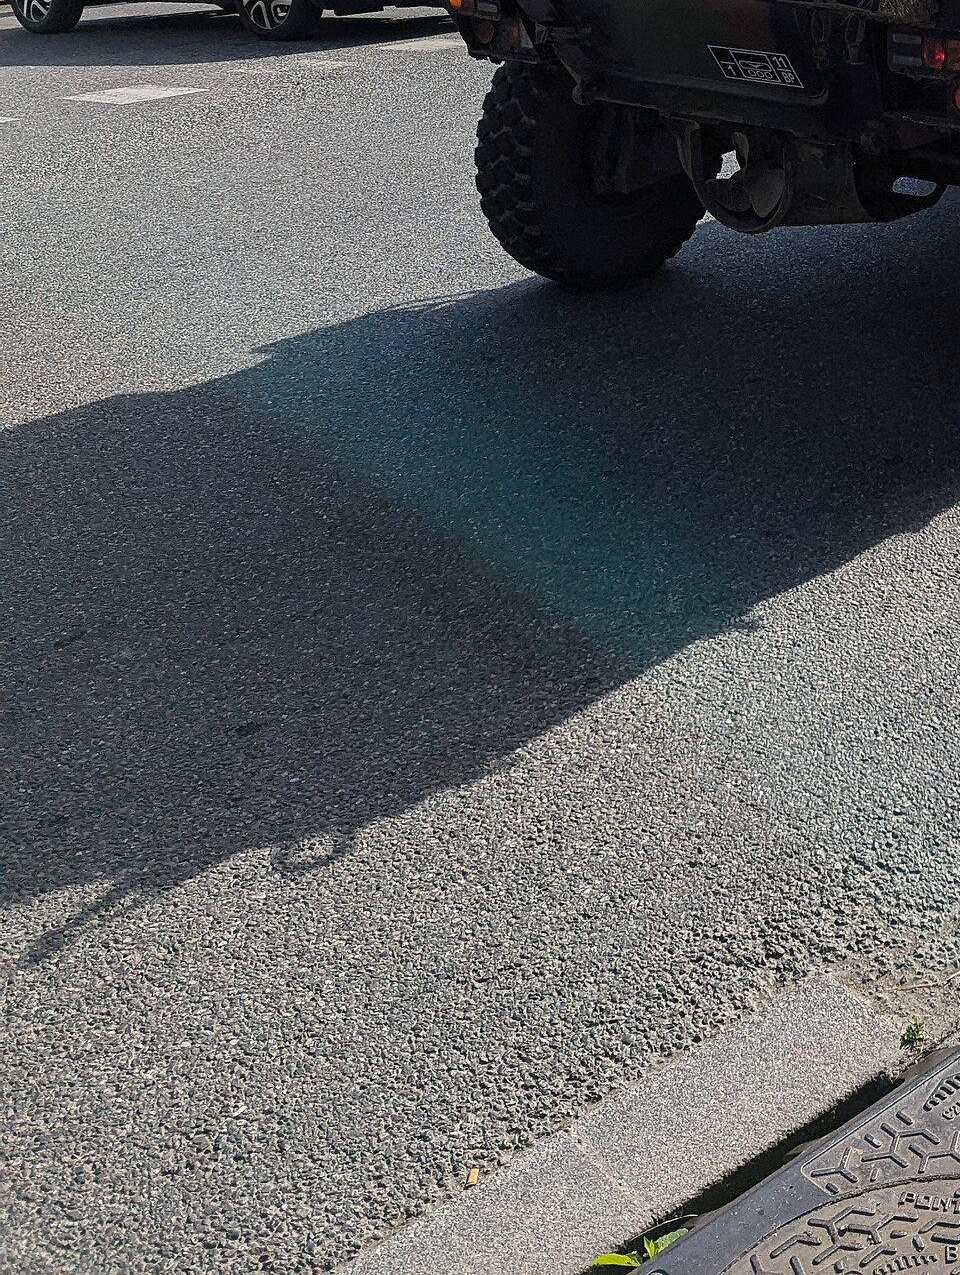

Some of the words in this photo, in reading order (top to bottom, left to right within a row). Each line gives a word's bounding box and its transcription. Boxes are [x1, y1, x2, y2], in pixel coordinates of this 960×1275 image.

[772, 56, 788, 69] 11
[726, 65, 737, 77] 1
[944, 1245, 959, 1264] B
